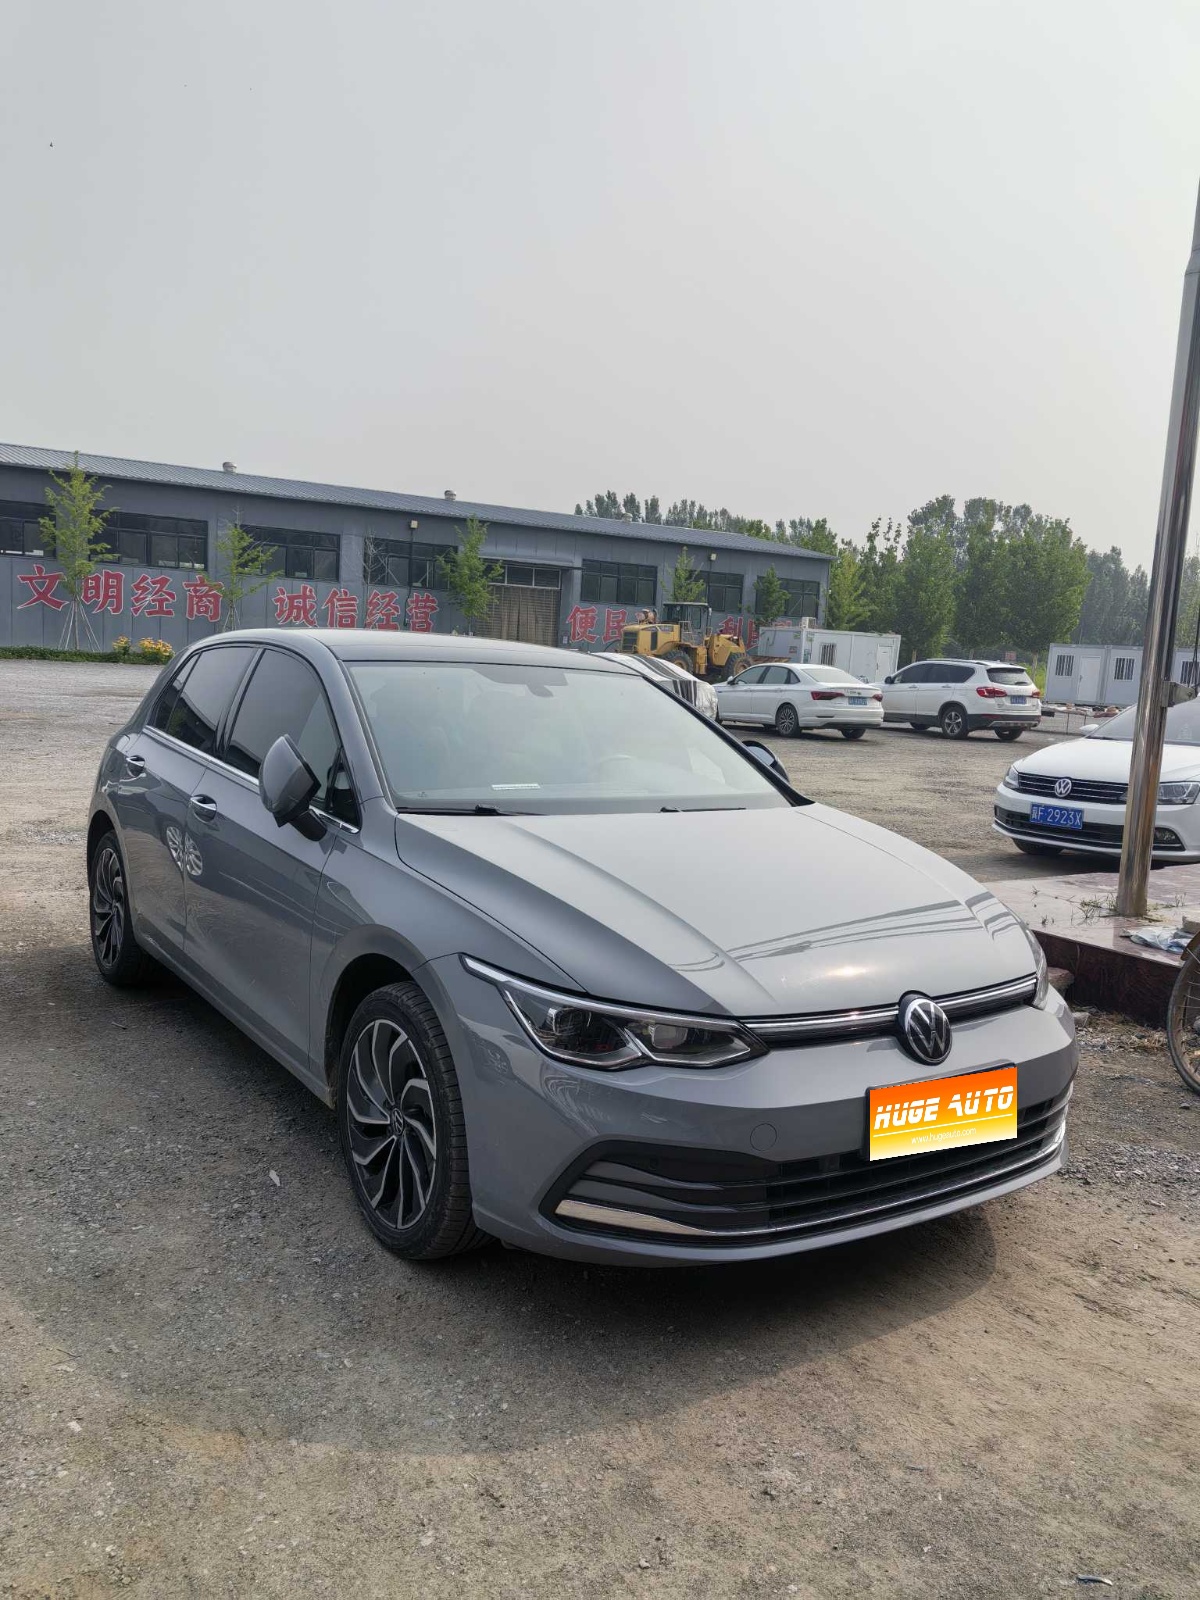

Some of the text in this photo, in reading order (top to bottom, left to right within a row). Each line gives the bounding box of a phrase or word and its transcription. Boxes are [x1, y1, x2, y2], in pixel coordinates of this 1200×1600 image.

[16, 563, 224, 623] 文明经商
[273, 586, 440, 632] 诚信经营
